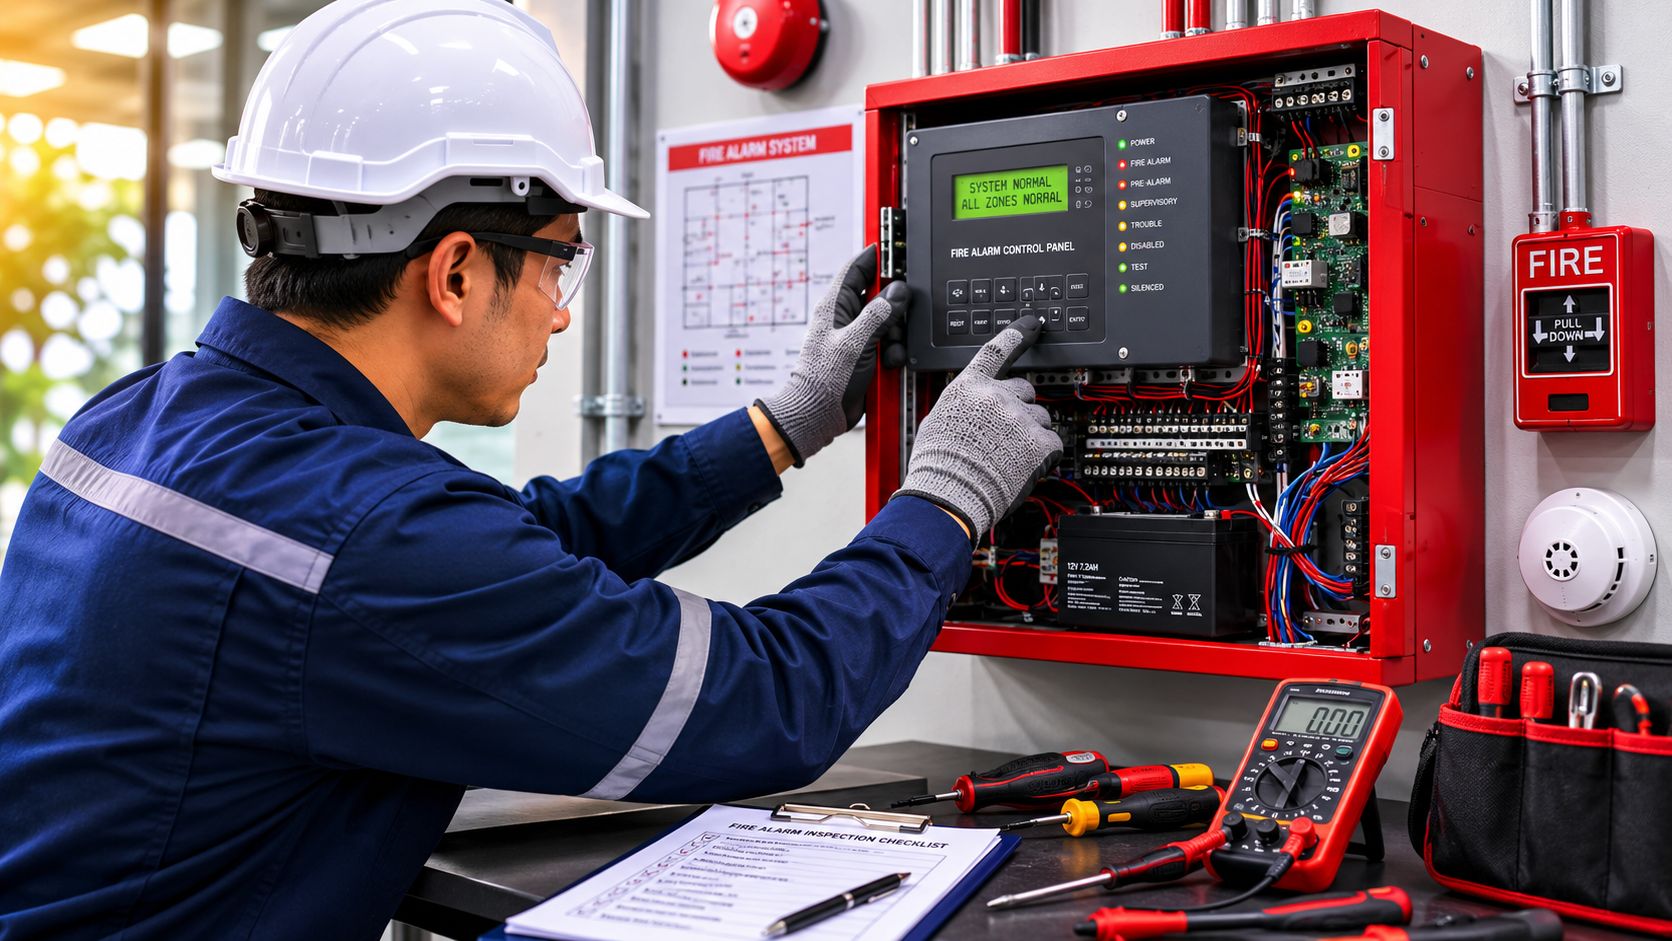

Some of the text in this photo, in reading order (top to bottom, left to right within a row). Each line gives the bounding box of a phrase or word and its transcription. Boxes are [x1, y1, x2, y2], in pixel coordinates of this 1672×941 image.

[1130, 138, 1155, 147] POWER
[699, 134, 817, 164] FIRE ALARM SYSTEM
[1130, 157, 1171, 167] FIRE ALARM
[962, 198, 980, 210] ALL
[986, 195, 1018, 208] ZONES
[1130, 197, 1178, 208] SUPERVISORY
[1131, 220, 1162, 229] TROUBLE
[950, 241, 1075, 258] FIRE ALARM CONTROL PANEL
[1131, 241, 1165, 250] DISABLED
[1131, 263, 1148, 271] TEST
[1529, 246, 1604, 278] FIRE
[1131, 284, 1164, 292] SILENCED
[1554, 318, 1582, 329] PULL
[1549, 330, 1584, 342] DOWN
[728, 822, 949, 849] FIRE ALARM INSPECTION CHECKLIST
